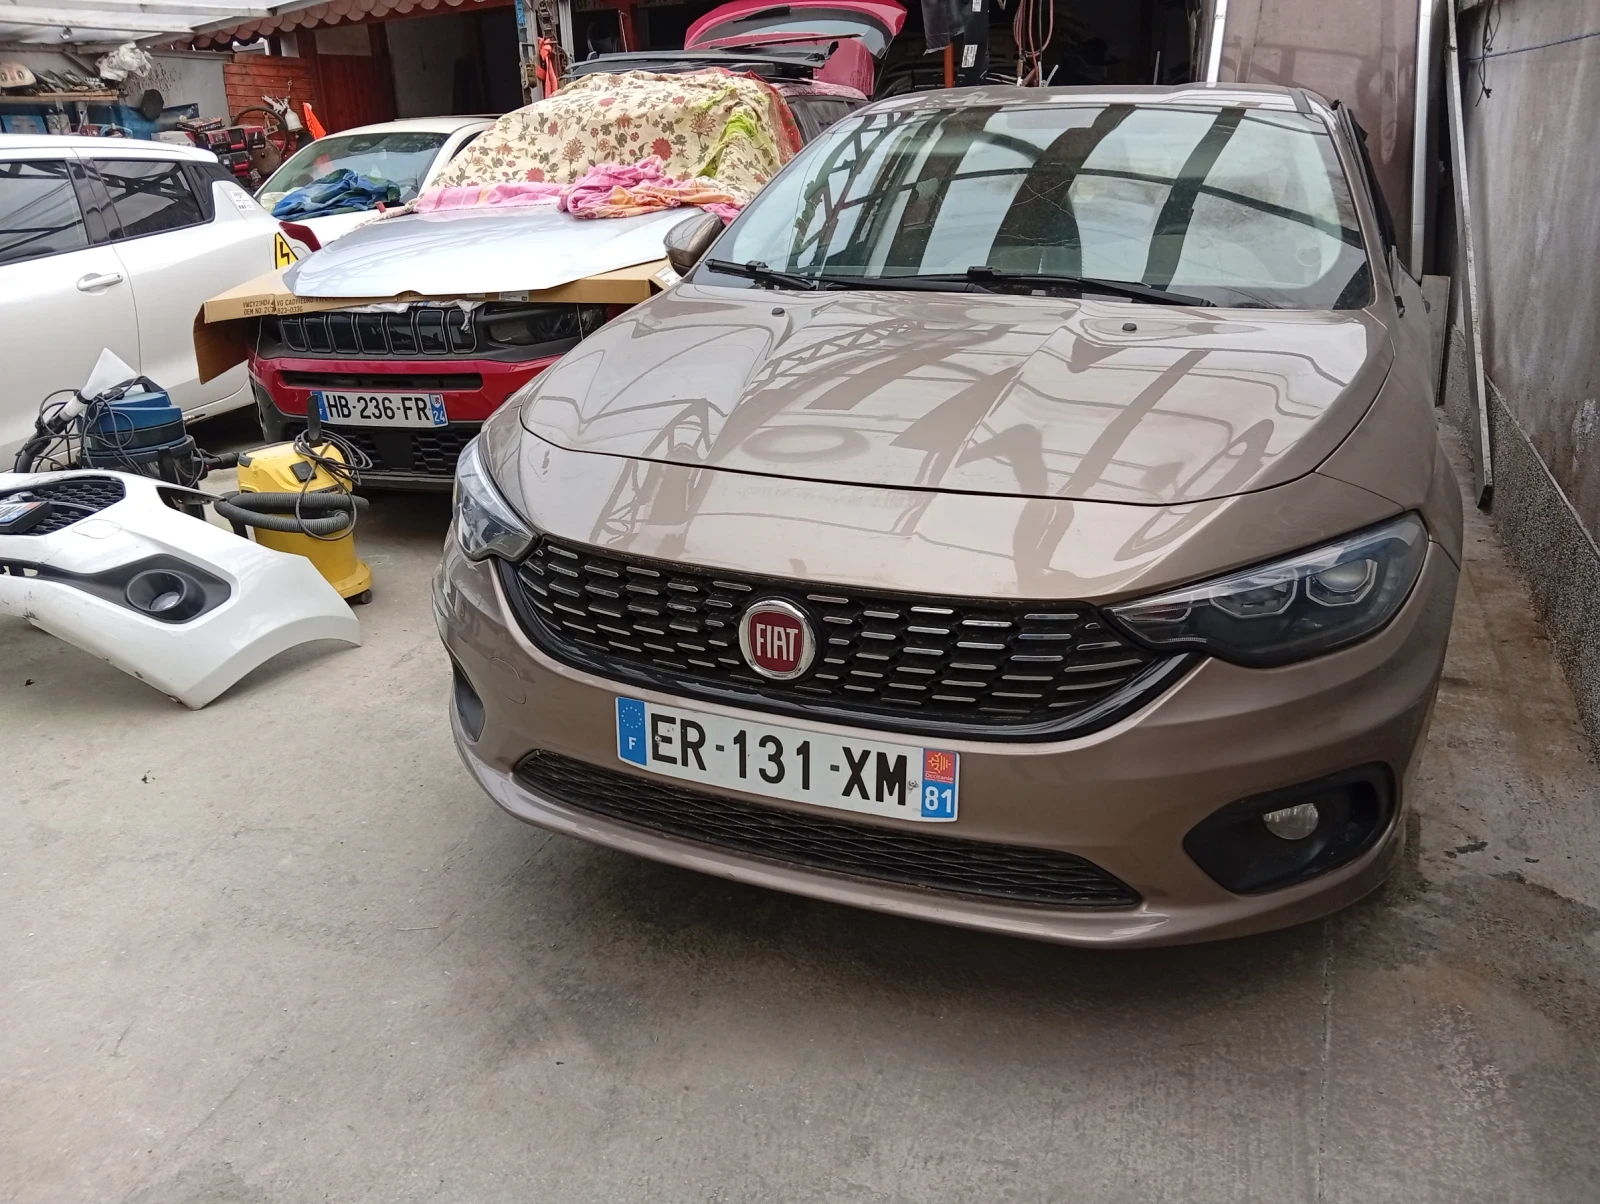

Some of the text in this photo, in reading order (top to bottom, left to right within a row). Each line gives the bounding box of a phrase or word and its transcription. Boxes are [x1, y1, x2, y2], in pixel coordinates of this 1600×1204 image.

[244, 307, 254, 316] OEM
[325, 394, 430, 421] HB-236-FR
[433, 410, 445, 422] 24
[756, 623, 799, 662] FIAT
[628, 736, 637, 750] F
[651, 713, 907, 806] ER-131-XM
[925, 772, 954, 781] Occitanie
[925, 785, 952, 813] 81
